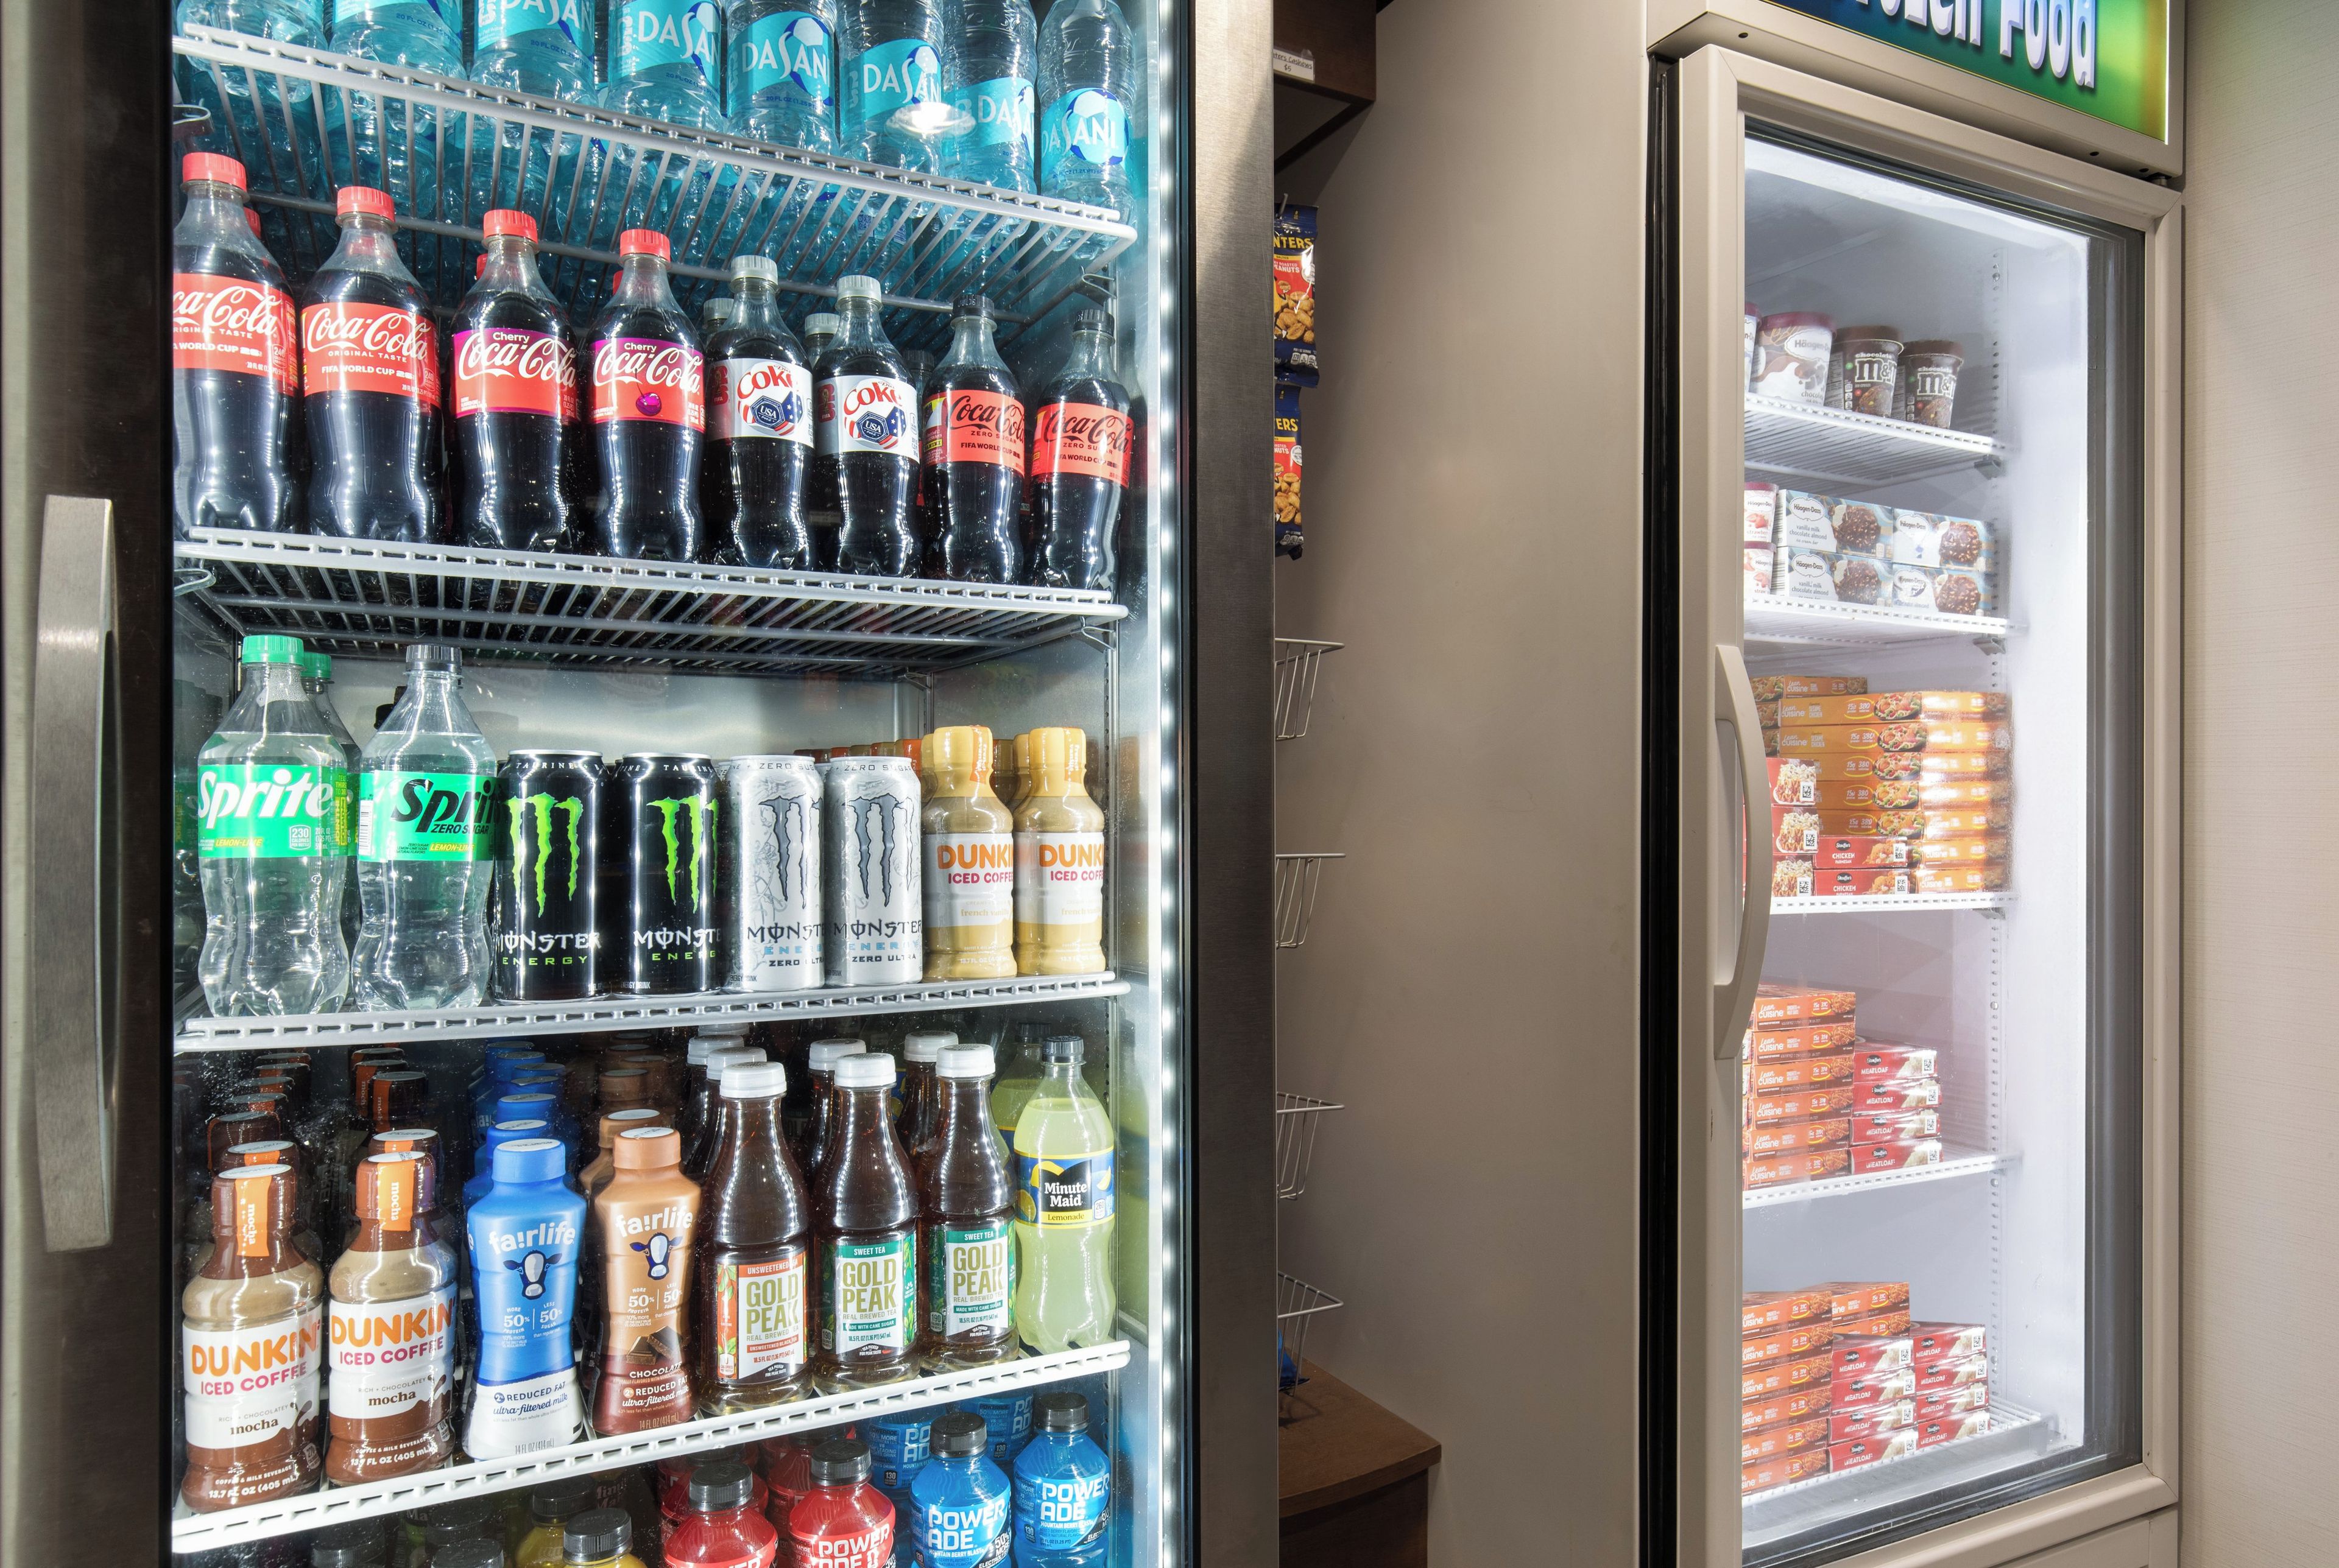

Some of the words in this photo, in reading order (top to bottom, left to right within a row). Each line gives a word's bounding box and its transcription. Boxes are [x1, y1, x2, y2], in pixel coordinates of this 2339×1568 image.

[742, 32, 830, 87] DASANI
[1288, 56, 1312, 69] Cashews
[1041, 109, 1117, 158] DASANI
[174, 286, 281, 336] ca-Cola
[219, 328, 253, 339] TASTE
[307, 307, 431, 360] Coca-Cola
[493, 331, 530, 345] Cherry
[378, 352, 407, 362] TASTE
[624, 342, 657, 357] Cherry
[459, 331, 576, 388] Coca-Cola
[322, 365, 338, 374] FIFA
[378, 367, 395, 376] CUP
[593, 343, 703, 394] Coca-Cola
[760, 406, 777, 419] USA
[865, 421, 881, 434] USA
[1043, 409, 1131, 453] Coca-Cola
[996, 434, 1017, 445] SUGAR
[1794, 504, 1821, 515] Häagen-Dazs
[1796, 561, 1823, 571] Häagen-Dazs
[1781, 709, 1805, 718] cuisine
[198, 768, 333, 829] Sprite
[391, 779, 496, 833] Spri
[292, 828, 309, 838] 230
[431, 825, 460, 834] ZERO
[462, 826, 489, 834] SUGAR
[215, 838, 263, 847] LEMON-LIME
[430, 843, 475, 851] LEMON-LIME
[937, 844, 1013, 869] DUNKI
[948, 873, 980, 884] ICED
[984, 872, 1013, 883] COFFE
[961, 908, 988, 917] french
[834, 918, 922, 940] MONSTER
[633, 926, 722, 953] MONSTE
[503, 955, 588, 966] ENERGY
[1759, 1044, 1783, 1052] cuisine
[1760, 1037, 1775, 1046] Lean
[1045, 1182, 1087, 1195] Minute
[391, 1182, 400, 1222] mocha
[1050, 1195, 1082, 1207] Maid
[964, 1232, 983, 1241] SWEET
[953, 1243, 1003, 1271] GOLD
[747, 1261, 789, 1274] UNSWEETENED
[842, 1259, 897, 1288] GOLD
[953, 1268, 1003, 1296] PEAK
[746, 1273, 799, 1307] GOLD
[842, 1283, 897, 1313] PEAK
[331, 1299, 456, 1348] DUNKIN'
[746, 1304, 799, 1334] PEAK
[881, 1320, 894, 1328] SUGAR
[931, 1314, 941, 1323] 190
[764, 1329, 789, 1340] BREWED
[822, 1331, 831, 1340] 190
[191, 1320, 320, 1376] DUNKIN'
[340, 1351, 375, 1365] ICED
[381, 1336, 443, 1363] COFFEE
[750, 1343, 777, 1351] UNSWEETENED
[1916, 1348, 1941, 1357] MEATLOAF
[629, 1361, 682, 1379] CHOCOLATE
[1840, 1362, 1866, 1373] MEATLOAF
[201, 1381, 234, 1396] ICED
[241, 1363, 306, 1391] COFFEE
[635, 1381, 676, 1396] REDUCED
[677, 1375, 688, 1388] FAT
[1921, 1374, 1946, 1385] MEATLOAF
[369, 1390, 416, 1407] mocha
[506, 1386, 551, 1402] REDUCED
[554, 1381, 566, 1396] FAT
[622, 1390, 675, 1407] ultra-filtered
[676, 1385, 689, 1400] milk
[1844, 1391, 1871, 1401] MEATLOAF
[244, 1405, 289, 1419] CHOCOLATEY
[493, 1396, 551, 1416] ultra-filtered
[552, 1393, 568, 1408] milk
[230, 1418, 278, 1435] mocha
[515, 1444, 521, 1454] 14
[522, 1444, 529, 1454] FL
[529, 1443, 535, 1453] OZ
[536, 1441, 546, 1453] (414
[245, 1474, 263, 1483] MILK
[263, 1466, 291, 1478] BEVERAGE
[208, 1489, 226, 1498] 13.7
[241, 1486, 255, 1496] OZ
[258, 1482, 280, 1494] (405
[1042, 1473, 1110, 1502] POWER
[928, 1499, 1005, 1530] POWER
[1040, 1501, 1085, 1522] ADE
[819, 1524, 889, 1557] POWER
[928, 1528, 974, 1550] ADE
[929, 1549, 950, 1558] MOUNTAIN
